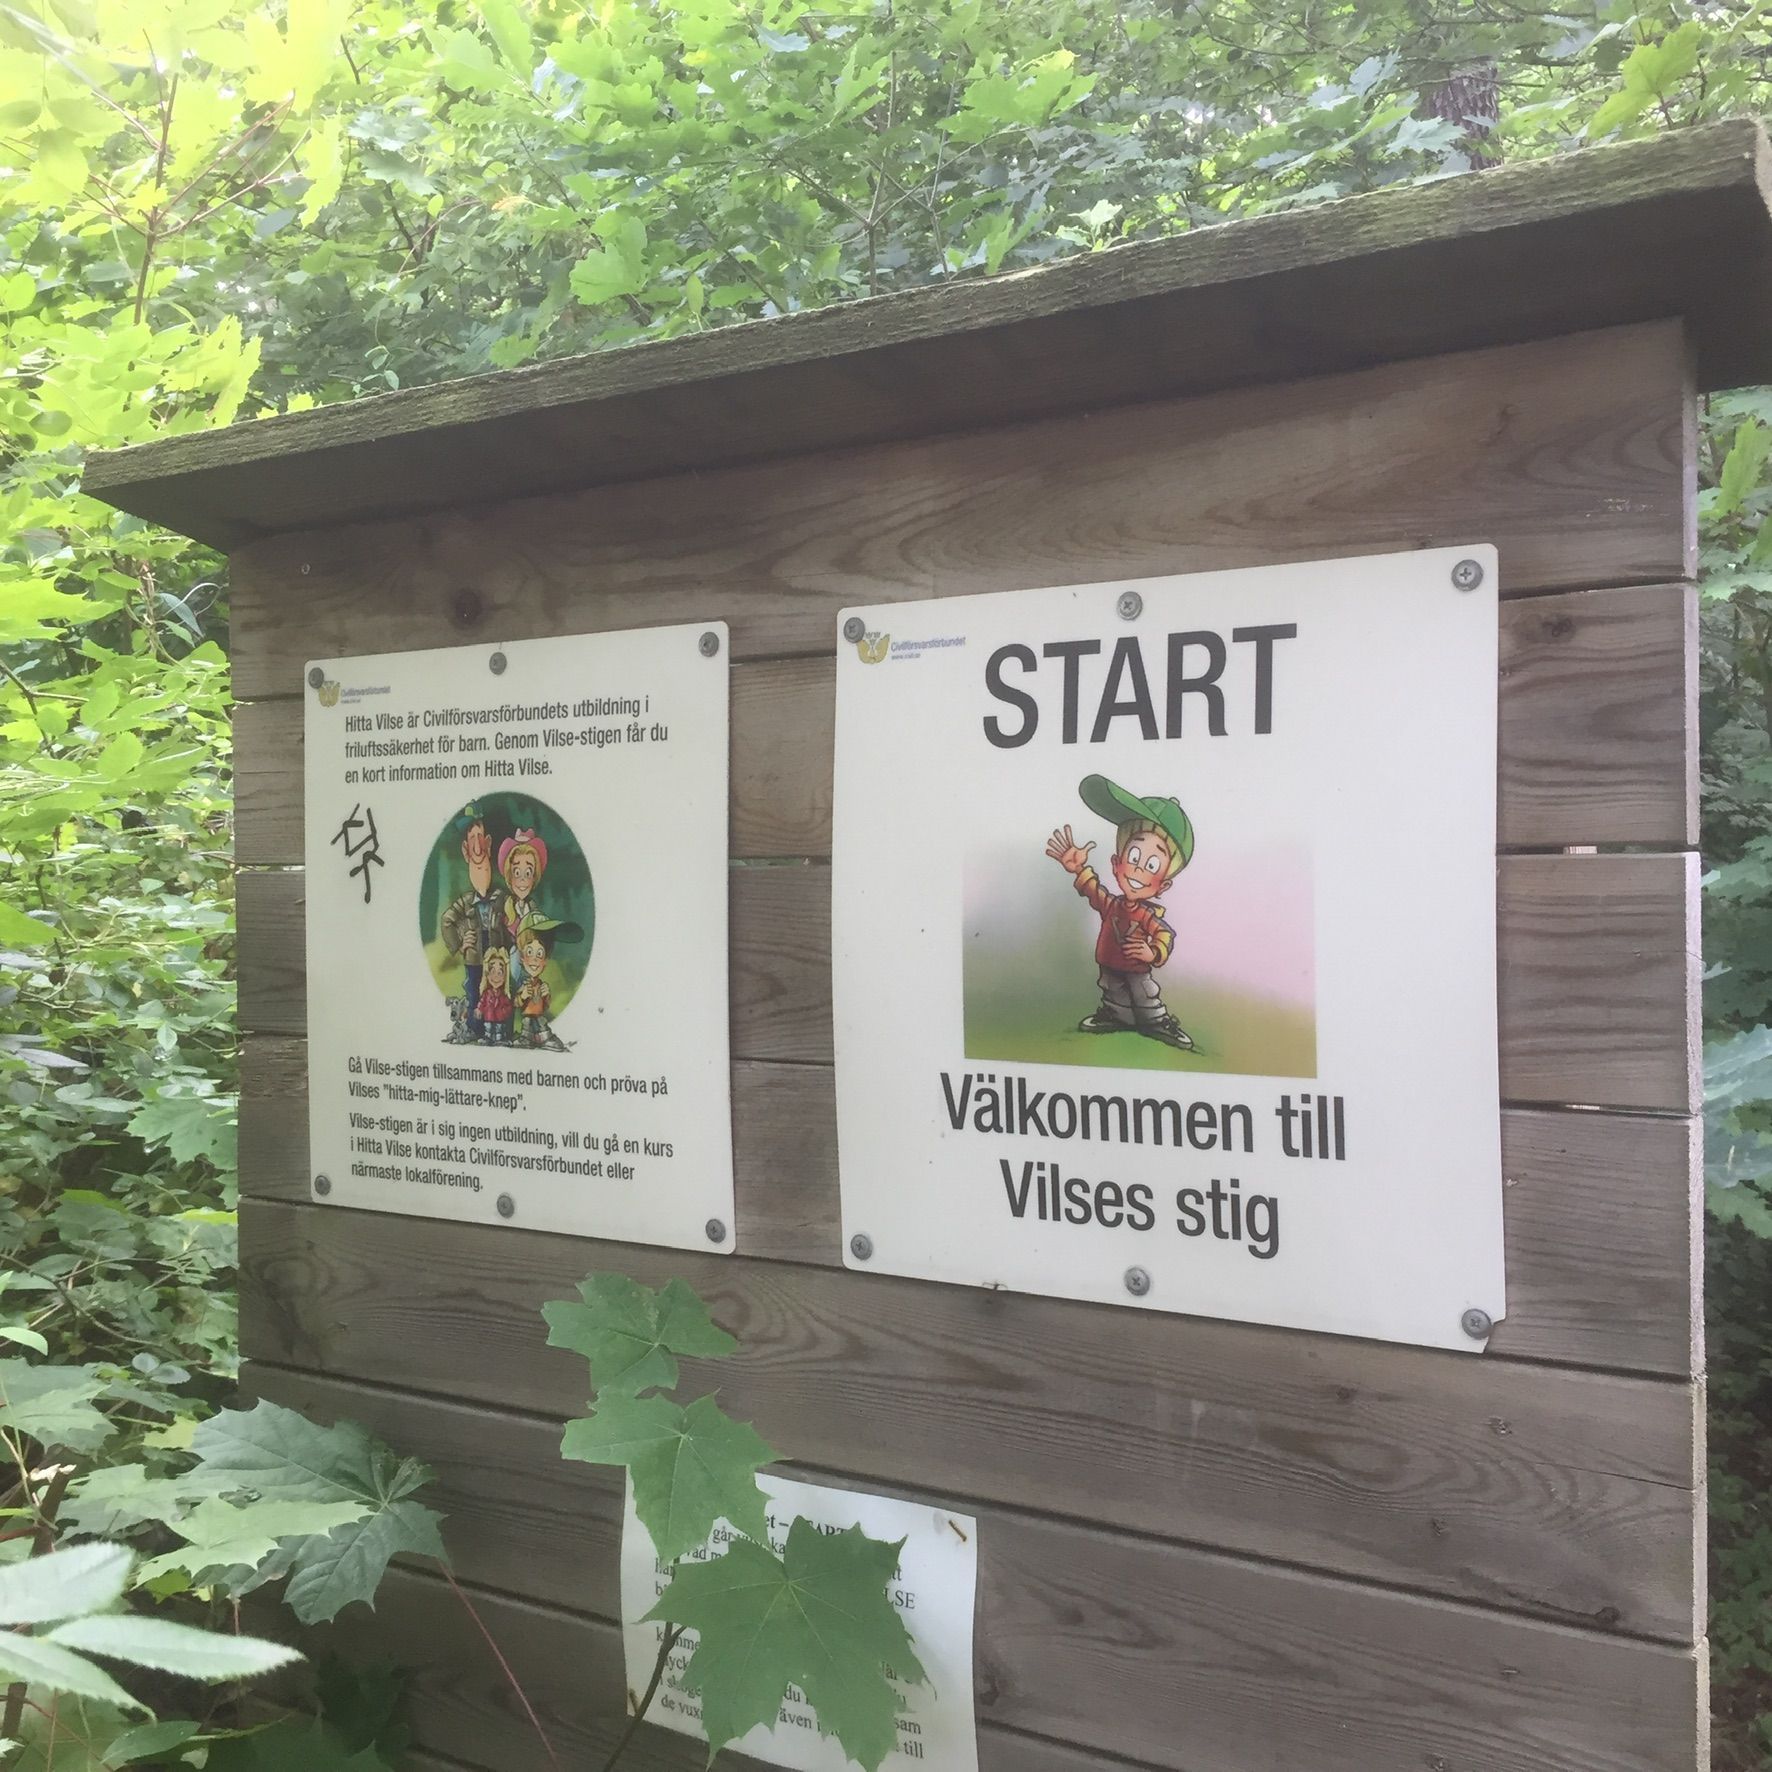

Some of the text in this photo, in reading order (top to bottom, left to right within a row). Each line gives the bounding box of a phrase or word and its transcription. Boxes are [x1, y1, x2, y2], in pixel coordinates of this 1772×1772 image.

[983, 623, 1297, 749] START
[345, 695, 649, 732] Hitta Vilse är Civilförsvarsförbundets utbildning i
[345, 723, 668, 758] friluftssäkerhet för barn. Genom Vilse-stigen får du
[345, 757, 553, 784] en kort information om Hitta Vilse.
[348, 1056, 668, 1096] Gå Vilse-stigen tillsammans med barnen och pröva på
[348, 1081, 380, 1099] Vilses
[349, 1112, 674, 1158] Vilse-stigen är i sig ingen utbildning, vill du gå en kurs
[940, 1072, 1347, 1161] Välkommen till
[350, 1137, 635, 1180] i Hitta Vilse kontakta Civilförsvarsförbundet eller
[351, 1161, 484, 1191] närmaste lokalförening.
[1000, 1158, 1281, 1259] Vilses stig
[779, 1707, 812, 1729] även
[904, 1740, 924, 1759] till
